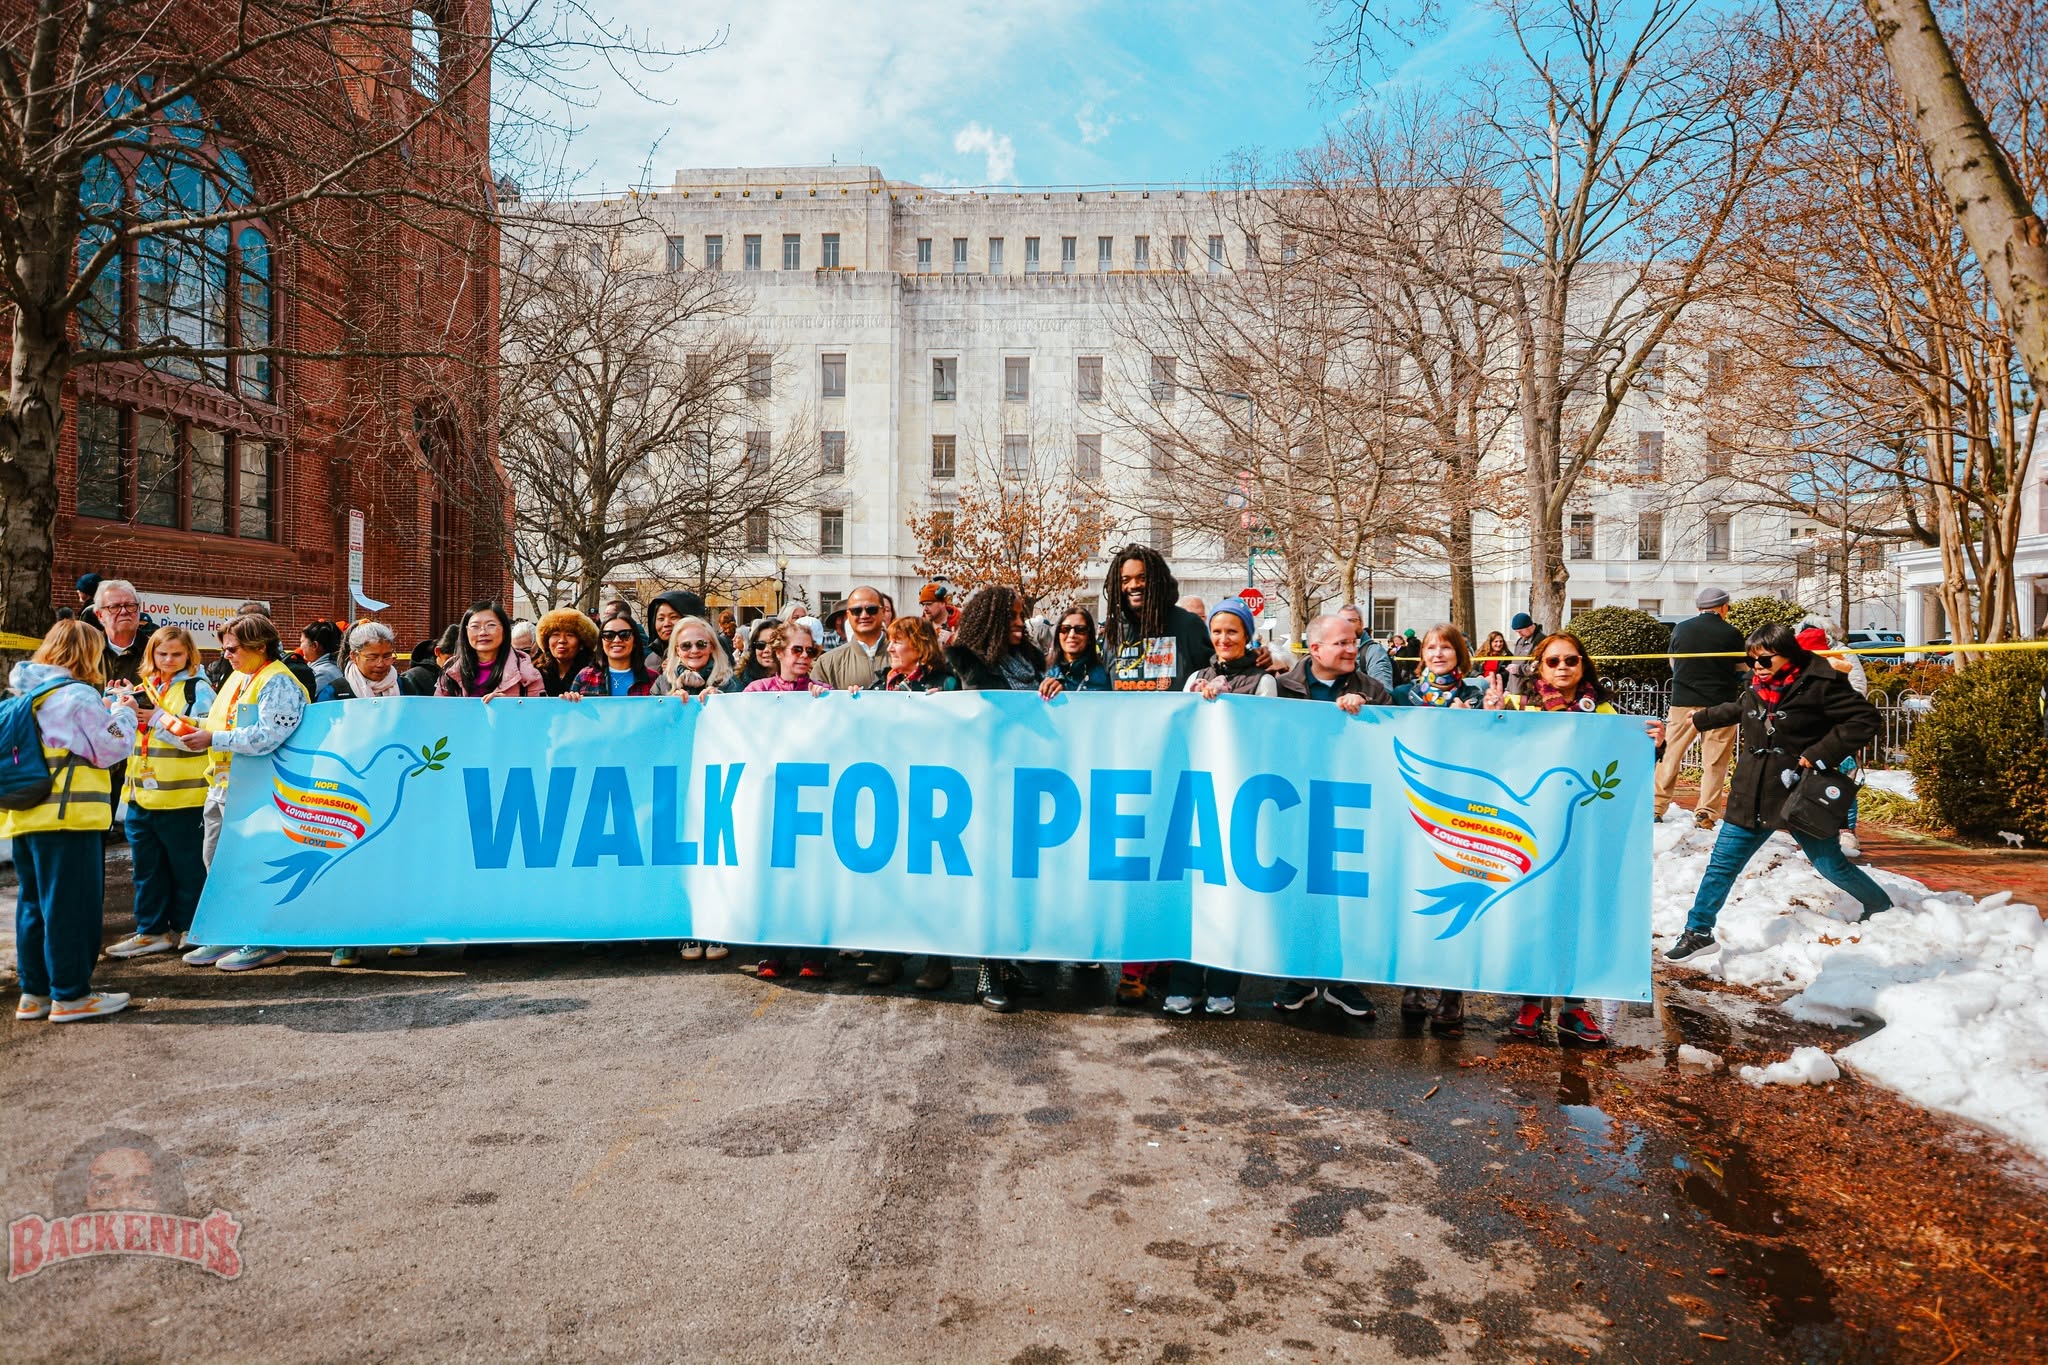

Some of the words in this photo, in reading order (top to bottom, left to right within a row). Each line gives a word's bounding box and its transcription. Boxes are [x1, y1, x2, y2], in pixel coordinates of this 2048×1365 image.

[142, 601, 170, 613] Love
[173, 602, 198, 615] Your
[201, 604, 237, 619] Neighb
[1241, 597, 1264, 608] TOP
[207, 620, 221, 632] He
[314, 780, 339, 791] HOPE
[300, 795, 358, 813] COMPASSION
[1467, 803, 1498, 817] HOPE
[285, 805, 358, 832] LOVING-KINDNESS
[299, 823, 343, 839] HARMONY
[462, 762, 746, 869] WALK
[770, 761, 974, 877] FOR
[1011, 767, 1372, 898] PEACE
[1451, 818, 1523, 843] COMPASSION
[303, 836, 327, 848] LOVE
[1432, 827, 1523, 865] LOVING-KINDNESS
[1456, 851, 1507, 871] HARMONY
[1461, 865, 1489, 880] LOVE
